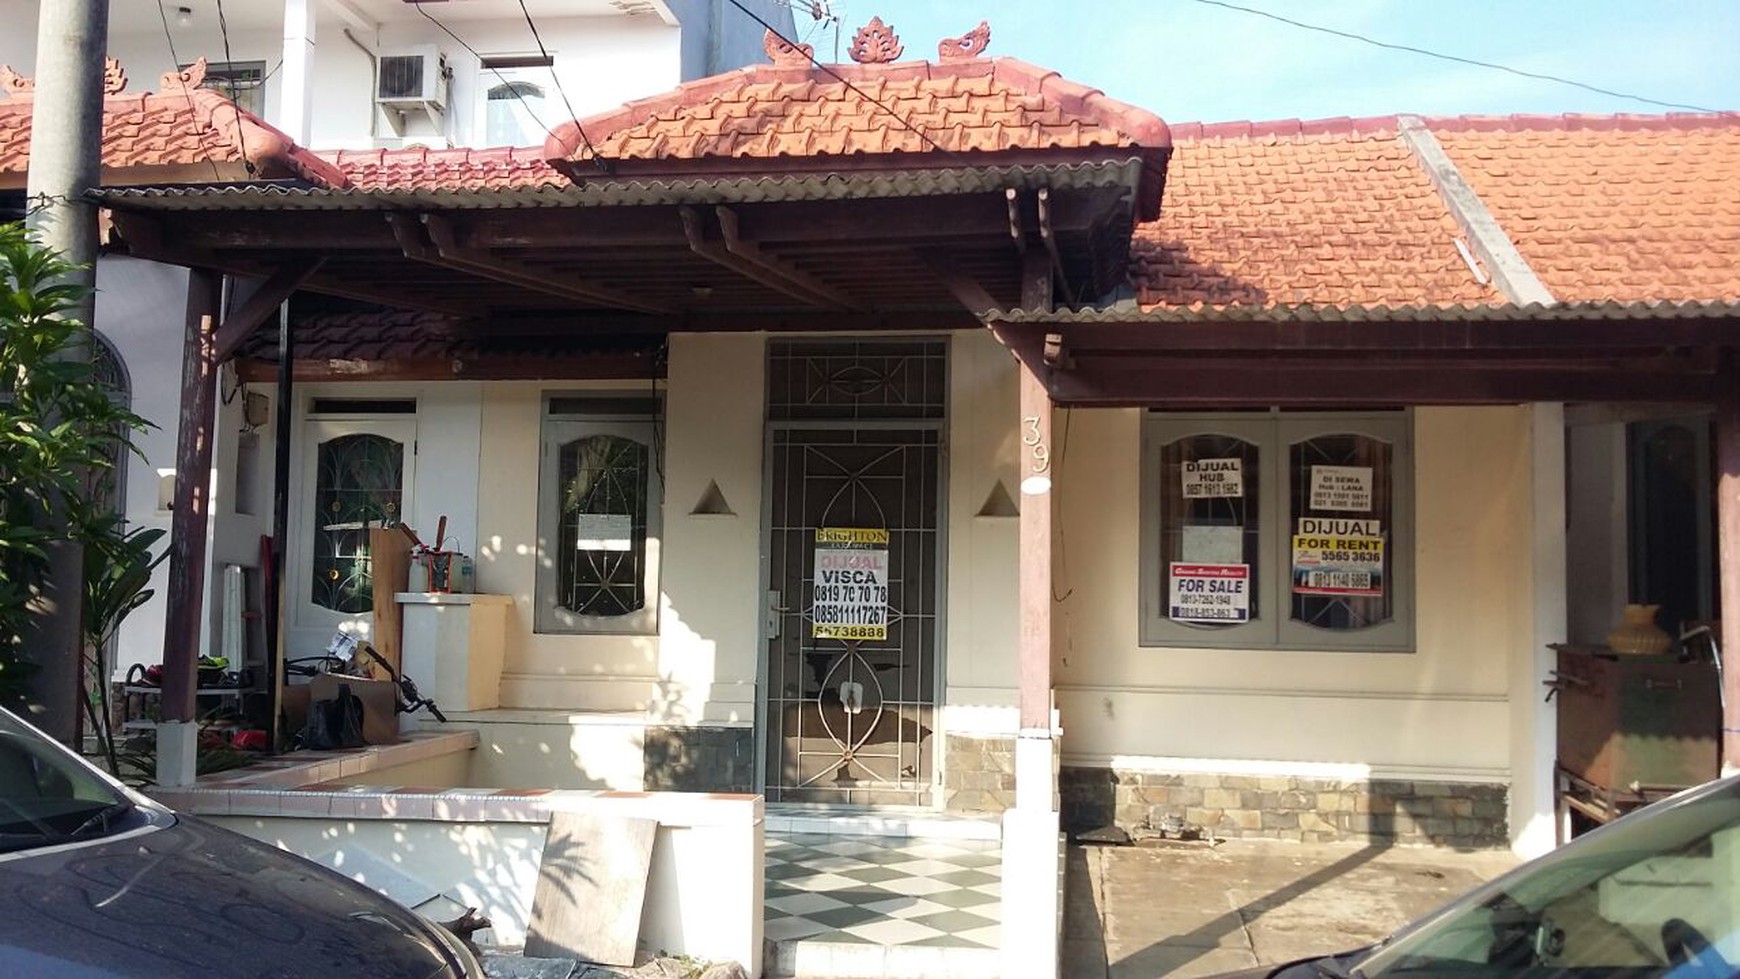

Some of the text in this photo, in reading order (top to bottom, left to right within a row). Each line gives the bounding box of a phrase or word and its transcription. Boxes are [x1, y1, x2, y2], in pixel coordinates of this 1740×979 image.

[1023, 414, 1049, 473] 39
[1186, 462, 1239, 473] DIJUAL
[1199, 473, 1225, 482] HUB
[1303, 520, 1377, 536] DIJUAL
[817, 530, 888, 542] BRIGHTON
[1298, 537, 1381, 551] FOR RENT
[1321, 551, 1350, 562] 5565
[1351, 551, 1381, 563] 3636
[1178, 578, 1243, 594] FOR SALE
[815, 585, 839, 602] 0819
[858, 586, 871, 603] 70
[874, 586, 887, 603] 78
[815, 605, 886, 625] 085811117267
